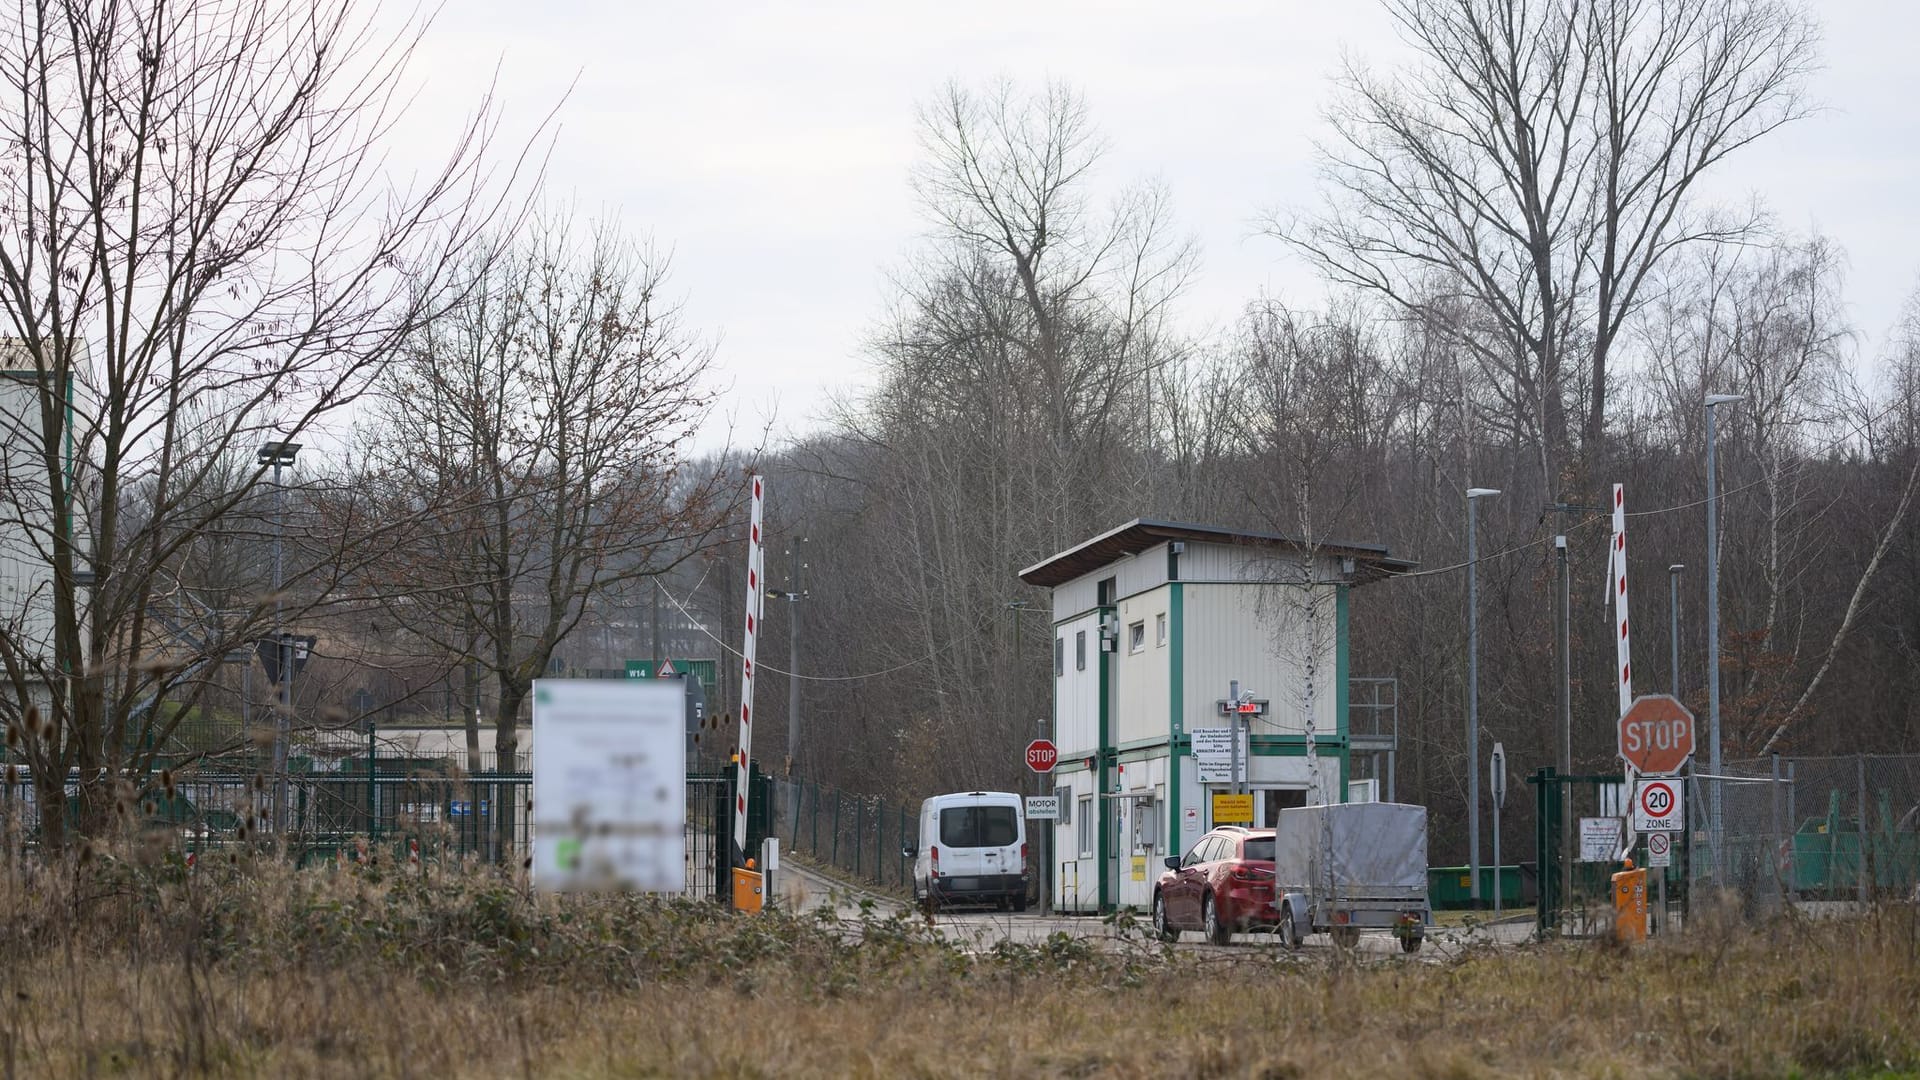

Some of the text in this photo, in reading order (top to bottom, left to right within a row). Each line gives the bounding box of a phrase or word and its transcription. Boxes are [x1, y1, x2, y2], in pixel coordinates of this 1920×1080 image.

[629, 669, 646, 678] W14
[1626, 720, 1686, 752] STOP
[1029, 750, 1055, 762] STOP
[1648, 792, 1668, 808] 20
[1646, 819, 1671, 829] ZONE
